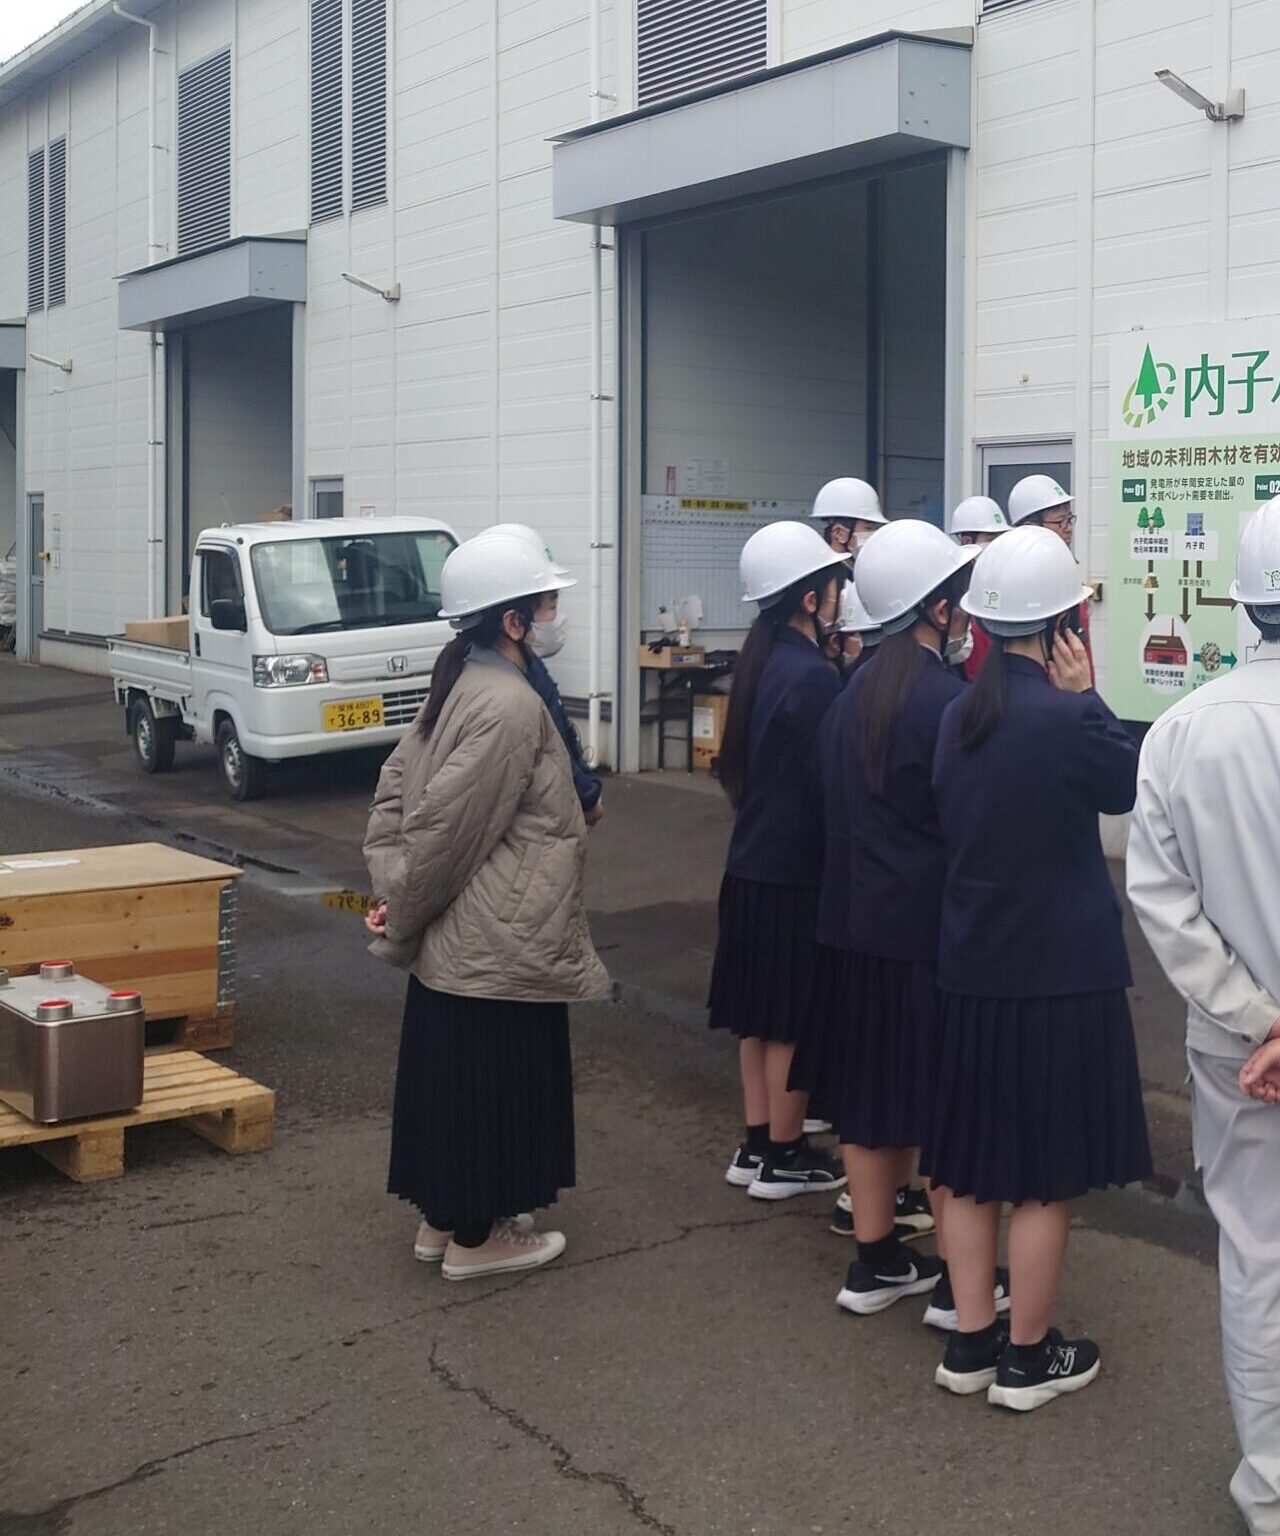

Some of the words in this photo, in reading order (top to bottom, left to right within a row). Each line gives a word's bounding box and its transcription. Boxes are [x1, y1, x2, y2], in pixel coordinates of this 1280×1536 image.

[1135, 484, 1145, 496] 01
[1269, 480, 1280, 493] 02
[1185, 541, 1205, 550] 内子町
[337, 709, 380, 728] 36-89
